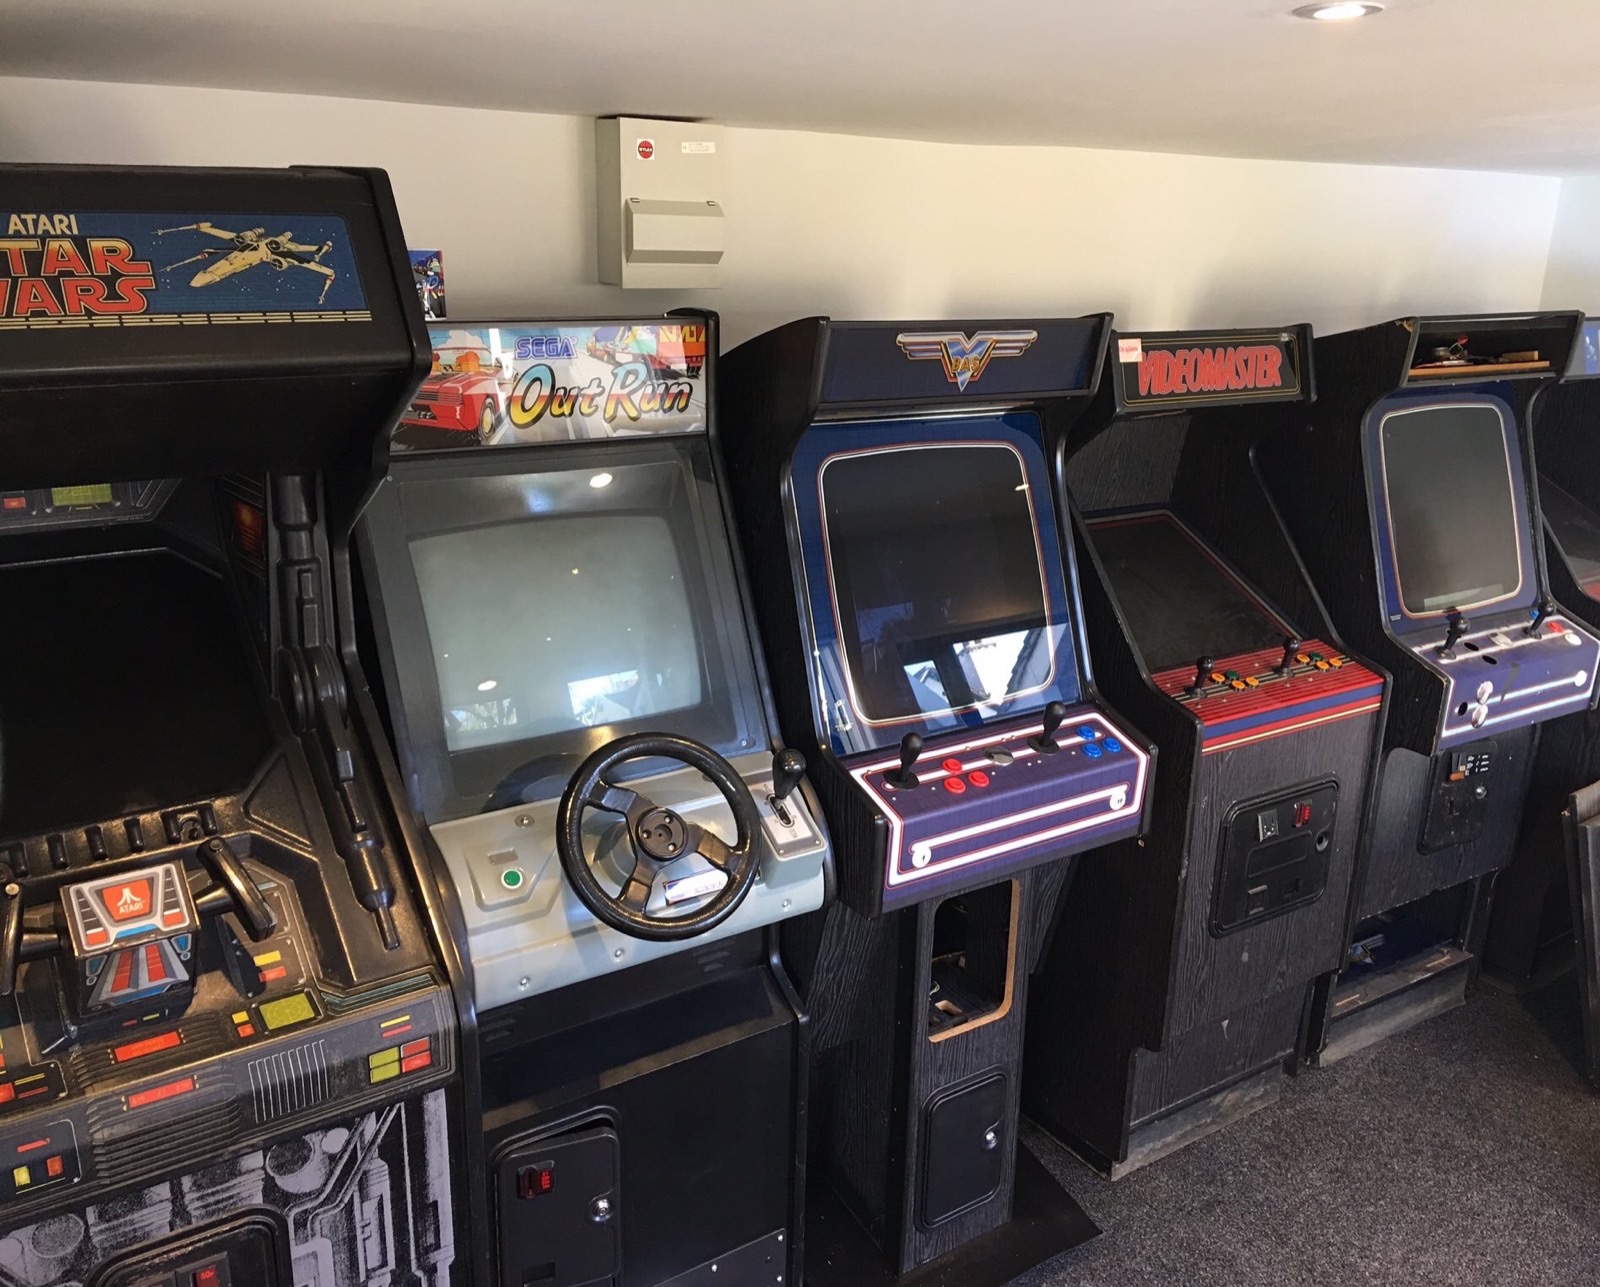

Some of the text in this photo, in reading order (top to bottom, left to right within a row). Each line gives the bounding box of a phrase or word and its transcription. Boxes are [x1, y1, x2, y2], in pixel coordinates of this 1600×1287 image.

[8, 214, 79, 235] ATARI
[0, 277, 155, 317] ARS
[514, 336, 578, 360] SEGA
[951, 356, 981, 372] BAS
[1138, 345, 1282, 396] VIDEOMASTER
[119, 901, 143, 914] ATARI
